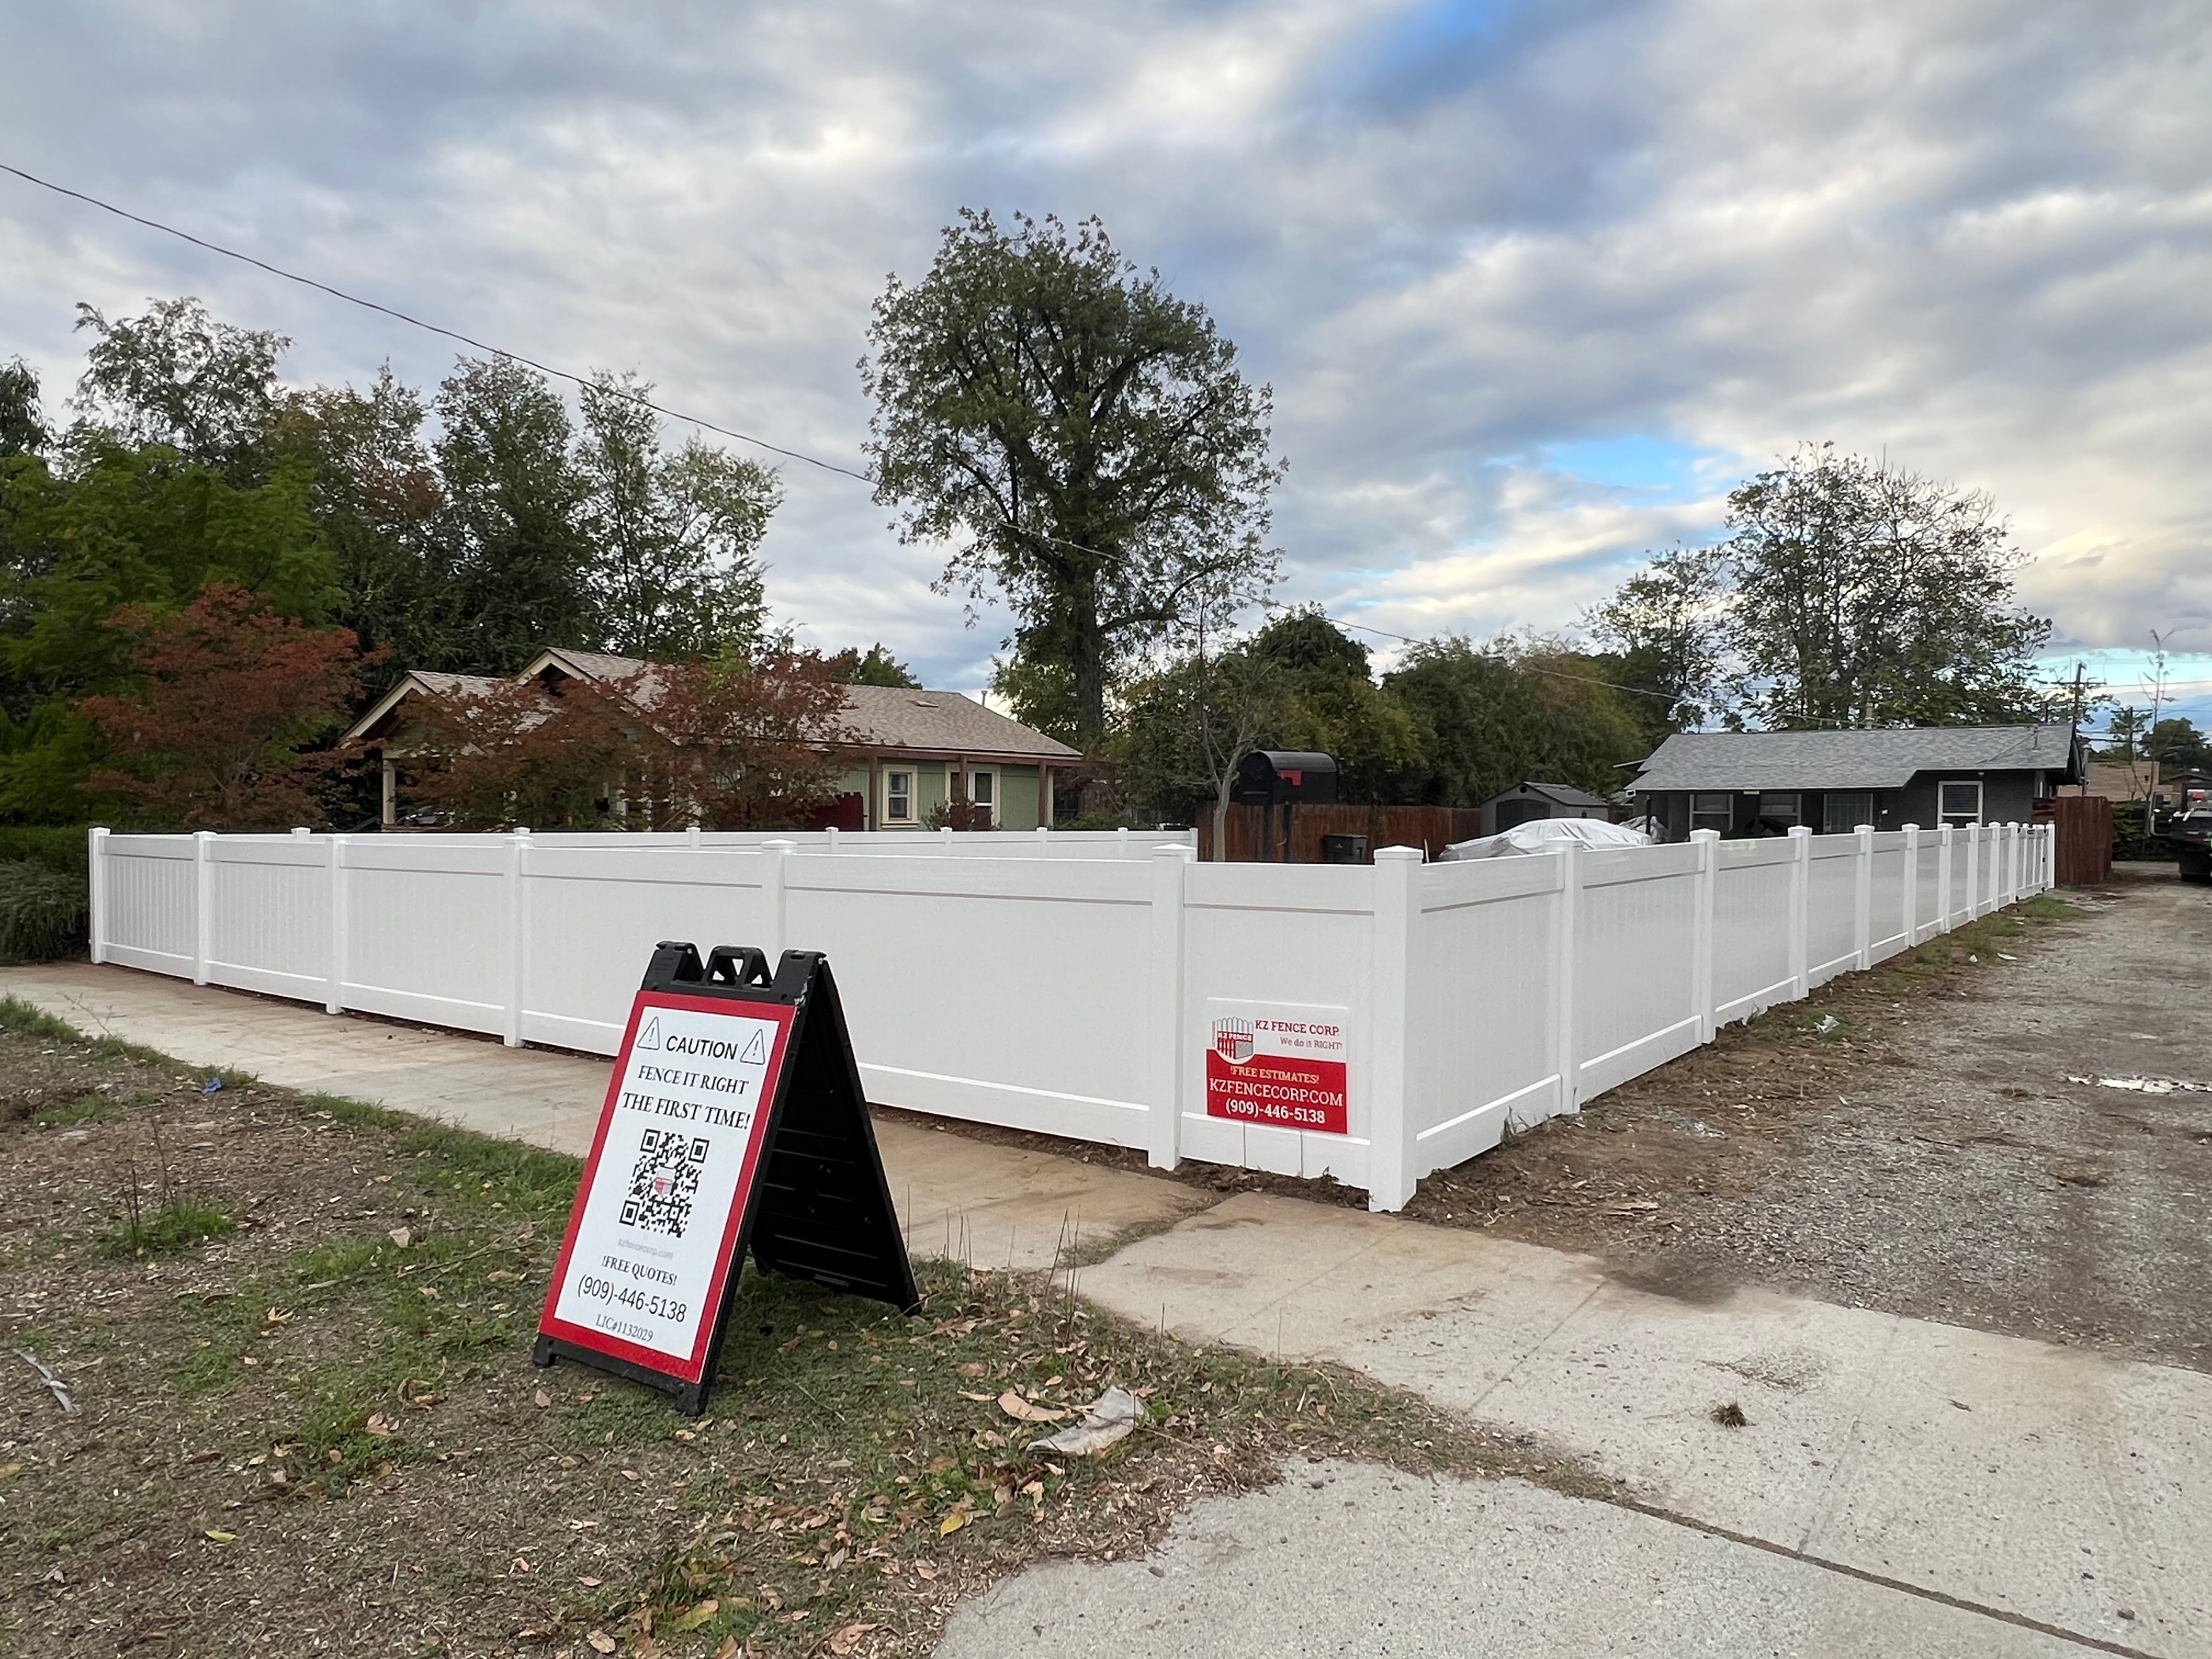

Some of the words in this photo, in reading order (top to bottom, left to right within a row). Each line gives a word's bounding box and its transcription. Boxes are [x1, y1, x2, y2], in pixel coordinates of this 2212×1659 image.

[1255, 1019, 1268, 1030] KZ
[1271, 1021, 1307, 1034] FENCE
[666, 1035, 738, 1060] CAUTION
[1280, 1037, 1293, 1046] We
[1294, 1038, 1304, 1047] do
[637, 1065, 681, 1084] FENCE
[682, 1071, 699, 1087] IT
[700, 1074, 749, 1095] RIGHT
[1209, 1077, 1343, 1107] KZFENCECORP.COM
[622, 1092, 654, 1113] THE
[654, 1098, 702, 1120] FIRST
[704, 1105, 751, 1130] TIME!
[1225, 1098, 1326, 1124] (909)-446-5138
[601, 1255, 631, 1273] !FREE
[631, 1263, 678, 1286] QUOTES!
[578, 1273, 687, 1322] (909)-446-5138
[595, 1313, 654, 1342] LIC#1132029
